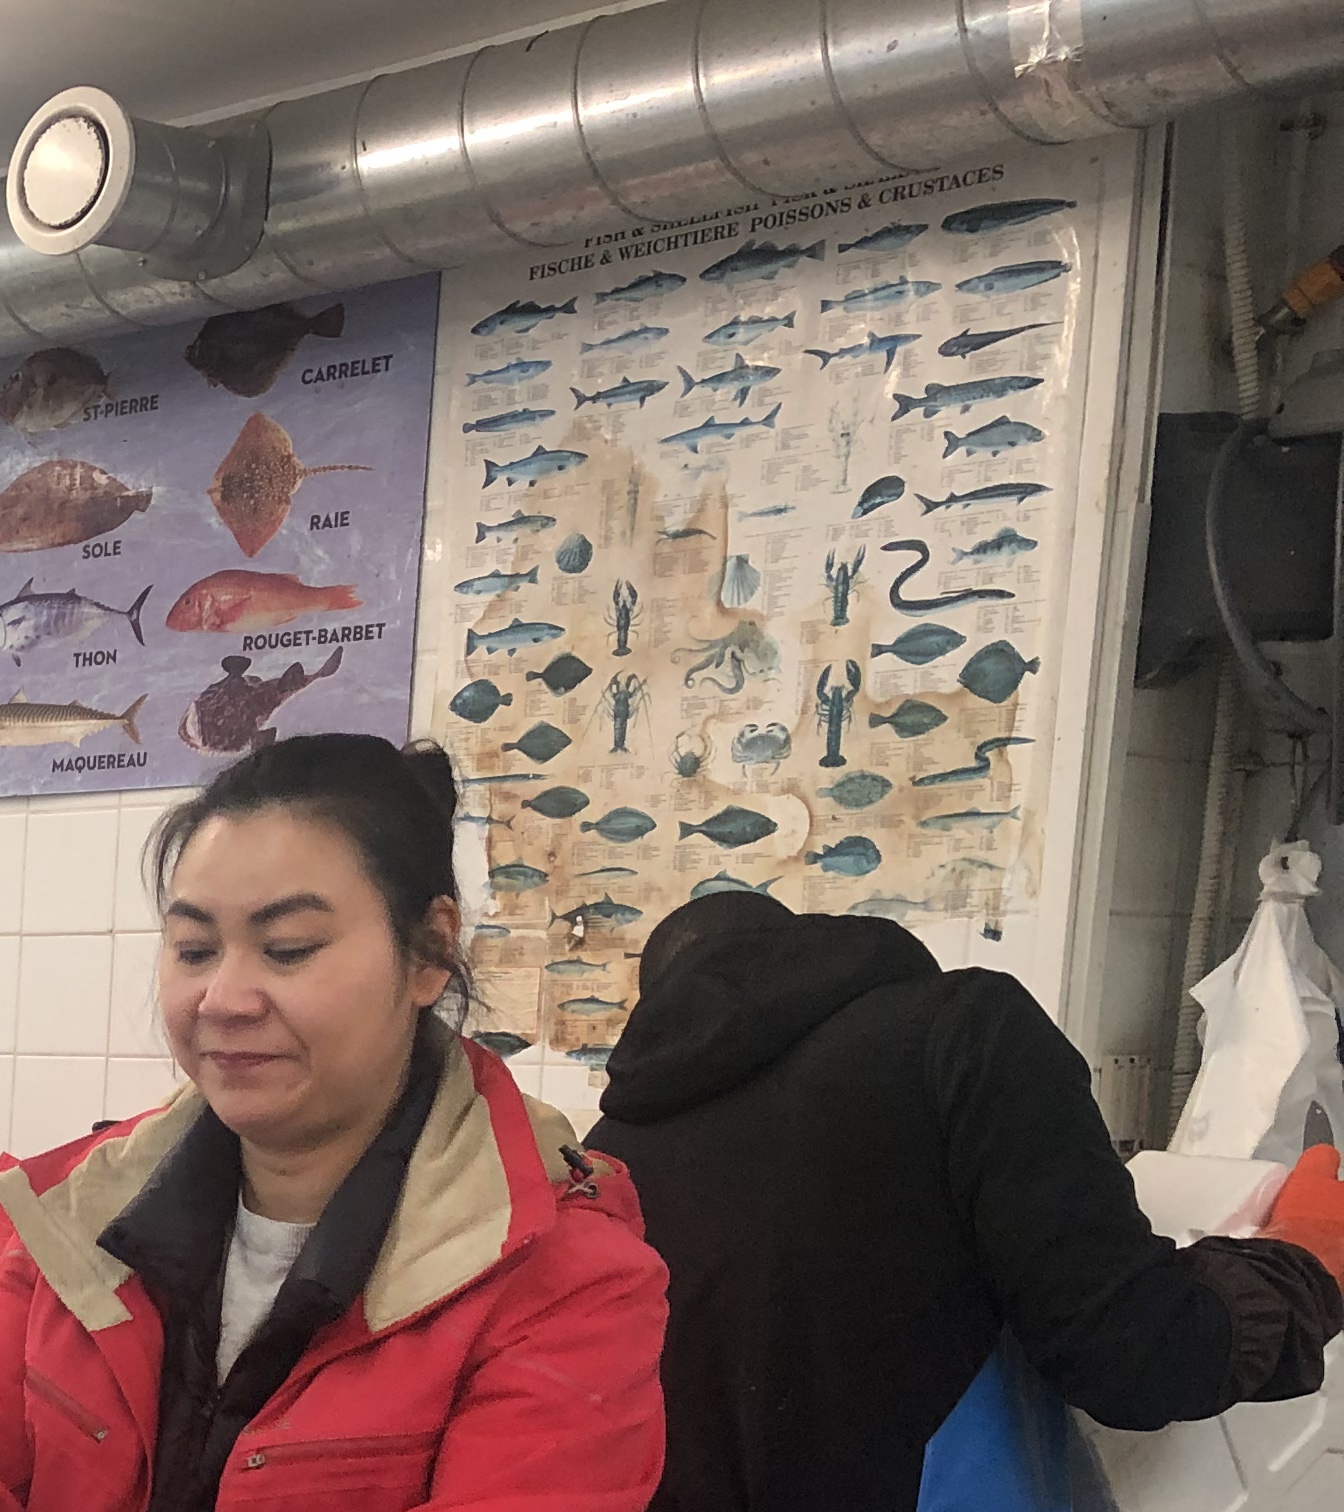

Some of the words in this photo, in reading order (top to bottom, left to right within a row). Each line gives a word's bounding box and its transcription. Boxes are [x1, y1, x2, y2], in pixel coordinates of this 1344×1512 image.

[528, 252, 595, 281] FISCHE
[600, 250, 613, 266] &
[617, 221, 740, 262] WEICHTIERE
[749, 194, 853, 233] POISSONS
[857, 193, 872, 210] &
[878, 163, 1006, 205] CRUSTACES
[301, 354, 394, 386] CARRELET
[82, 394, 160, 422] ST-PIERRE
[309, 510, 351, 531] RAIE
[81, 540, 122, 560] SOLE
[242, 622, 387, 652] ROUGET-BARBET
[73, 649, 118, 668] THON
[51, 751, 148, 773] MAQUEREAU
